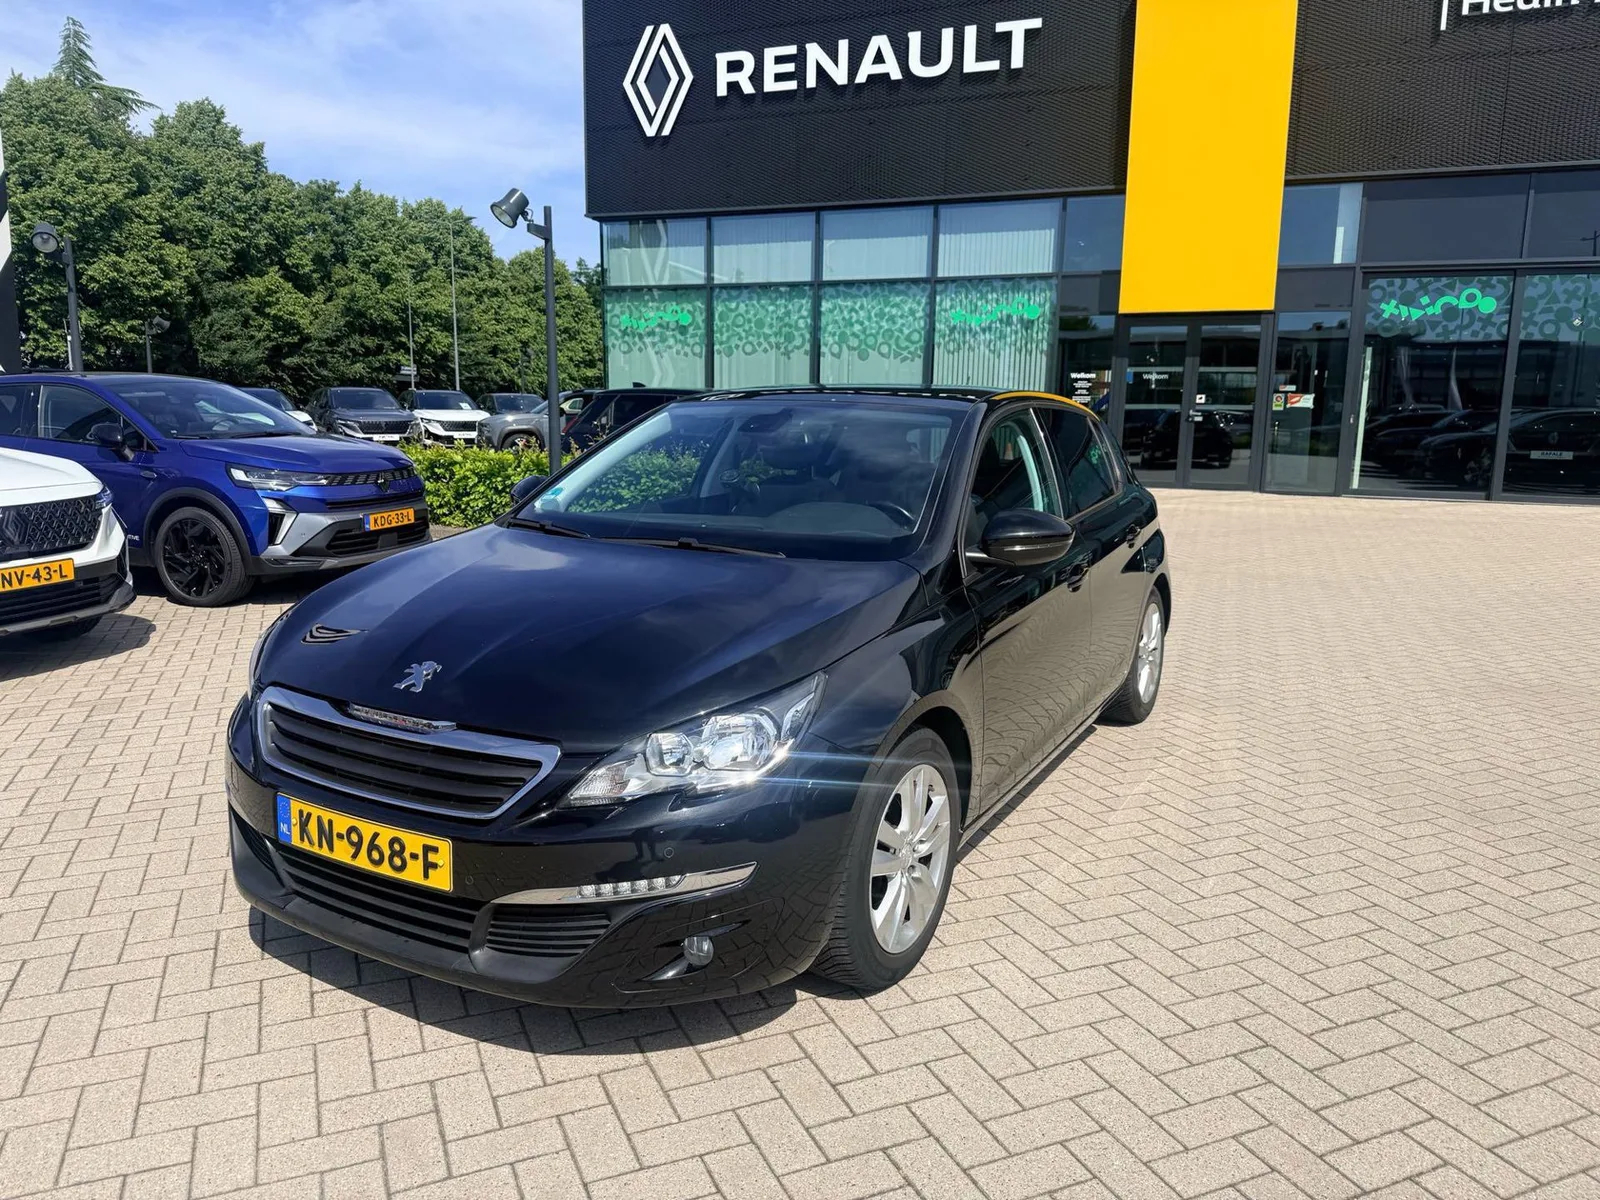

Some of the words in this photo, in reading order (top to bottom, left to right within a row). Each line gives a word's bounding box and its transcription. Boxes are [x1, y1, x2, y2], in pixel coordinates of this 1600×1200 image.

[715, 18, 1042, 97] RENAULT
[1142, 372, 1169, 380] Welkom
[373, 511, 412, 528] KDG-33-L
[0, 564, 68, 589] NV-43-L
[280, 821, 290, 835] NL
[298, 809, 439, 880] KN-968-F
